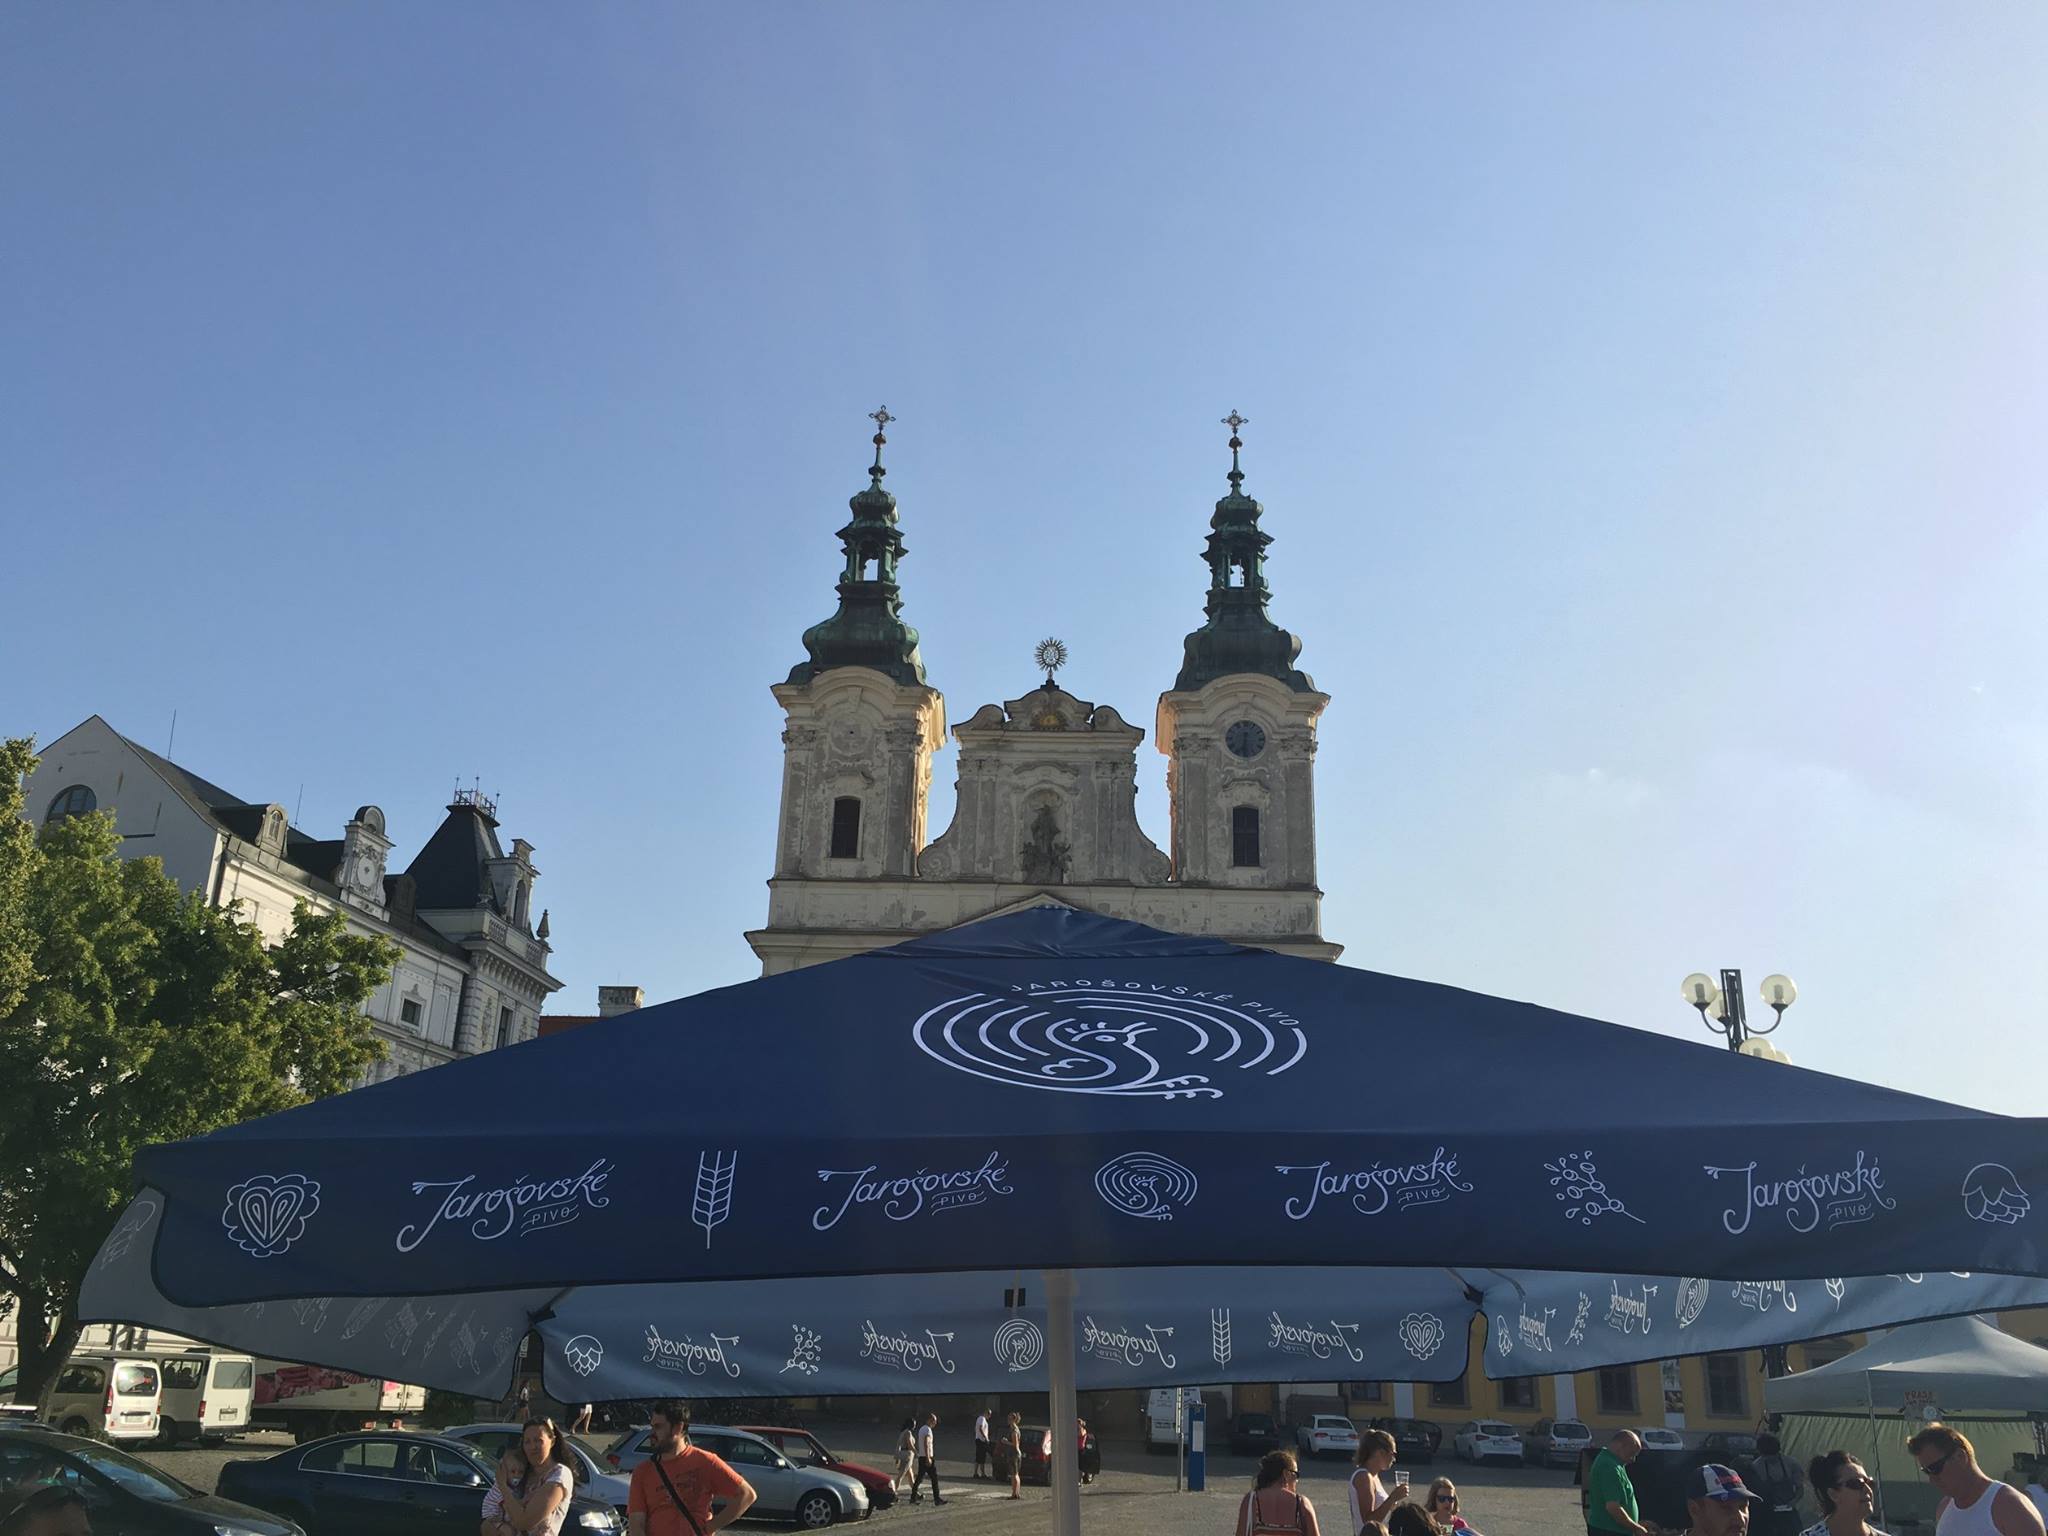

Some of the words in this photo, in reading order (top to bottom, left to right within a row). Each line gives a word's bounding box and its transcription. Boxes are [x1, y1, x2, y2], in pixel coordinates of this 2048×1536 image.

[1240, 1001, 1300, 1026] PIVO
[940, 1192, 977, 1206] PIVO
[1405, 1188, 1441, 1201] PIVO
[532, 1206, 571, 1225] PIVO
[1834, 1204, 1867, 1219] PIVO
